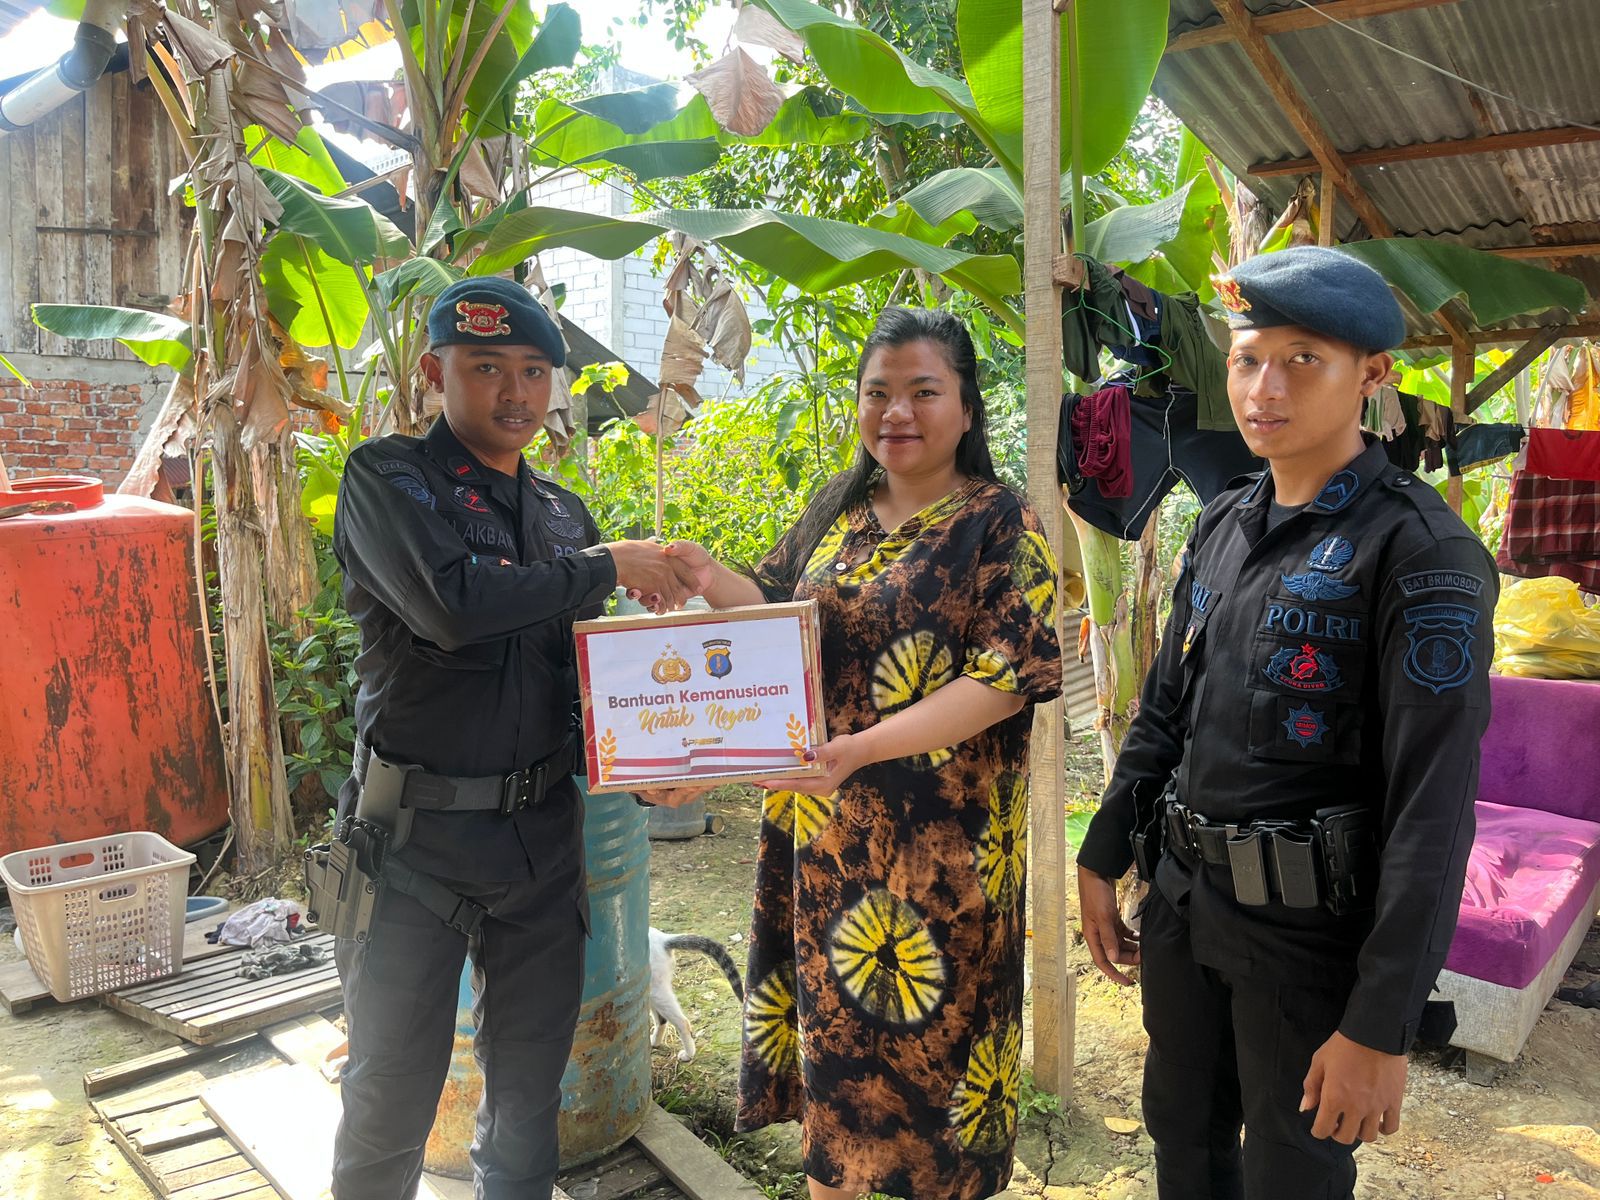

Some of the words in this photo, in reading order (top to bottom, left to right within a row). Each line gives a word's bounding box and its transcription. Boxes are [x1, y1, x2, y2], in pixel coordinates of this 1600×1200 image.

[462, 522, 516, 552] AKBAR
[554, 544, 578, 558] PO
[1406, 577, 1424, 591] SAT
[1427, 574, 1477, 592] BRIMOBDA
[1264, 604, 1362, 641] POLRI
[608, 692, 675, 709] Bantuan
[679, 682, 789, 703] Kemanusiaan
[638, 705, 695, 735] Untuk
[705, 702, 762, 731] Negeri
